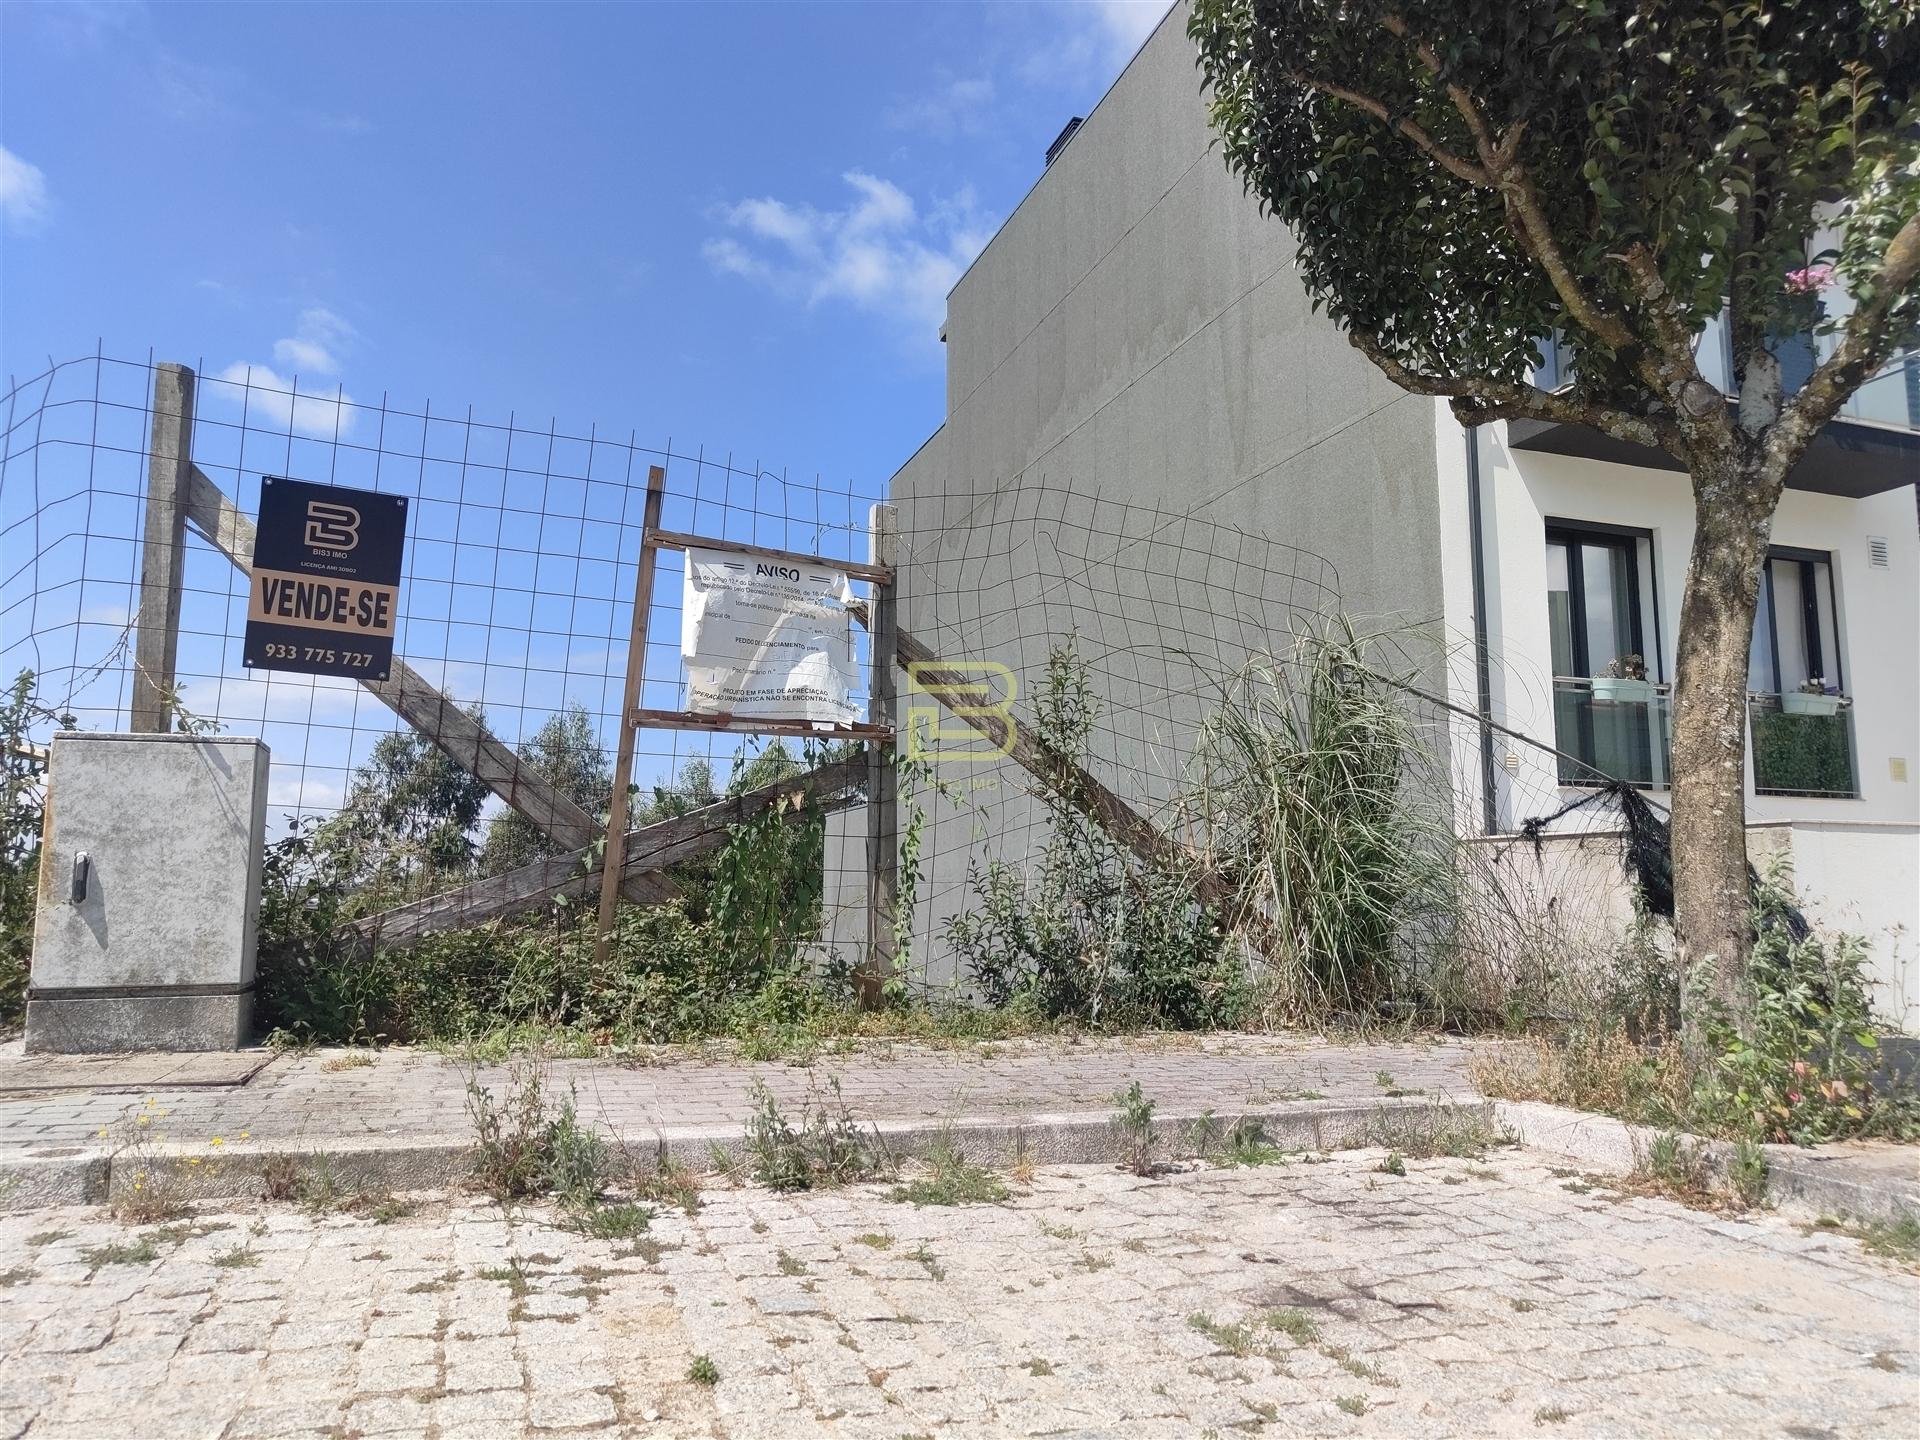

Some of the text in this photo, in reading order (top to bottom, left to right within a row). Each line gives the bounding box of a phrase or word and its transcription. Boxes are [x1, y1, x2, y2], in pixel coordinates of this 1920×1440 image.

[313, 548, 348, 559] BIS3 IMO
[300, 561, 326, 569] LICENÇA
[755, 563, 800, 582] AVISO
[262, 576, 390, 629] VENDE-SE
[735, 636, 754, 645] PEDIDO
[265, 643, 373, 668] 933 775 727
